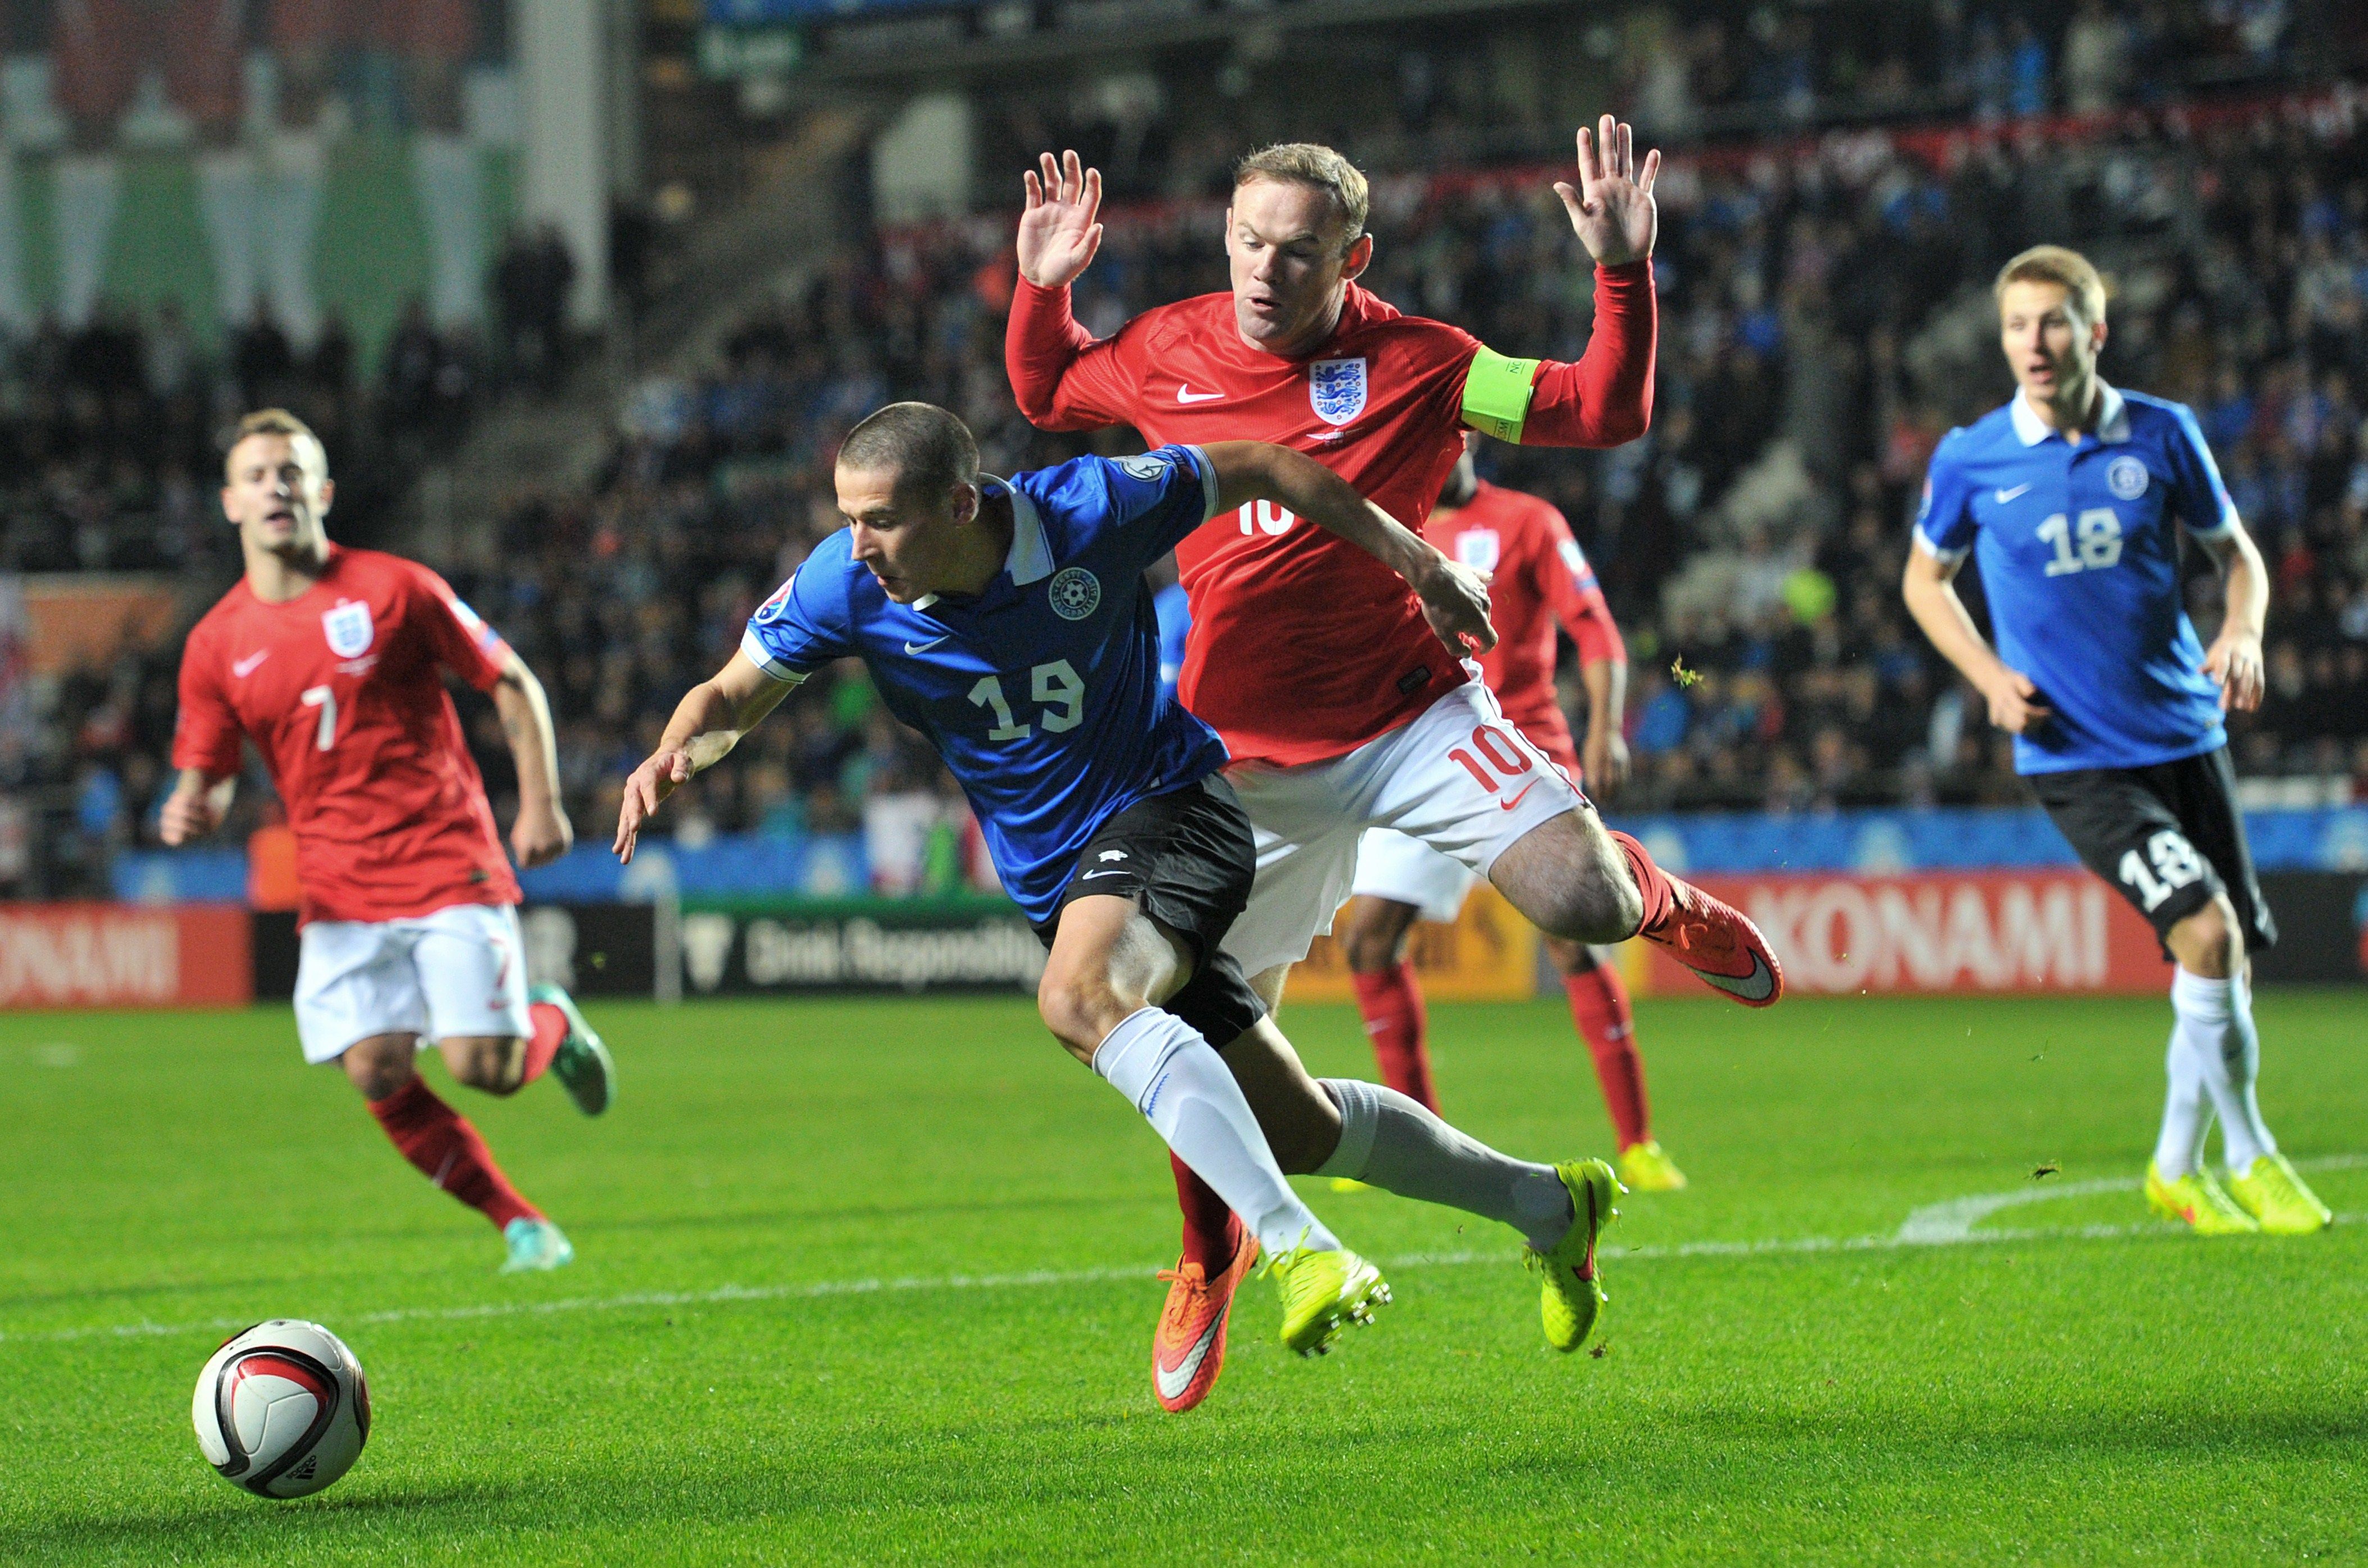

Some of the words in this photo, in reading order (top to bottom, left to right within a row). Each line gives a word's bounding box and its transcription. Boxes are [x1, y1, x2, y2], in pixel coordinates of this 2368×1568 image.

[2036, 507, 2123, 577] 18
[301, 685, 336, 751] 7
[967, 659, 1085, 741] 19
[1448, 725, 1533, 793] 10
[2119, 829, 2203, 914] 18
[0, 911, 181, 1004] NAMI
[1748, 883, 2107, 992] KONAMI
